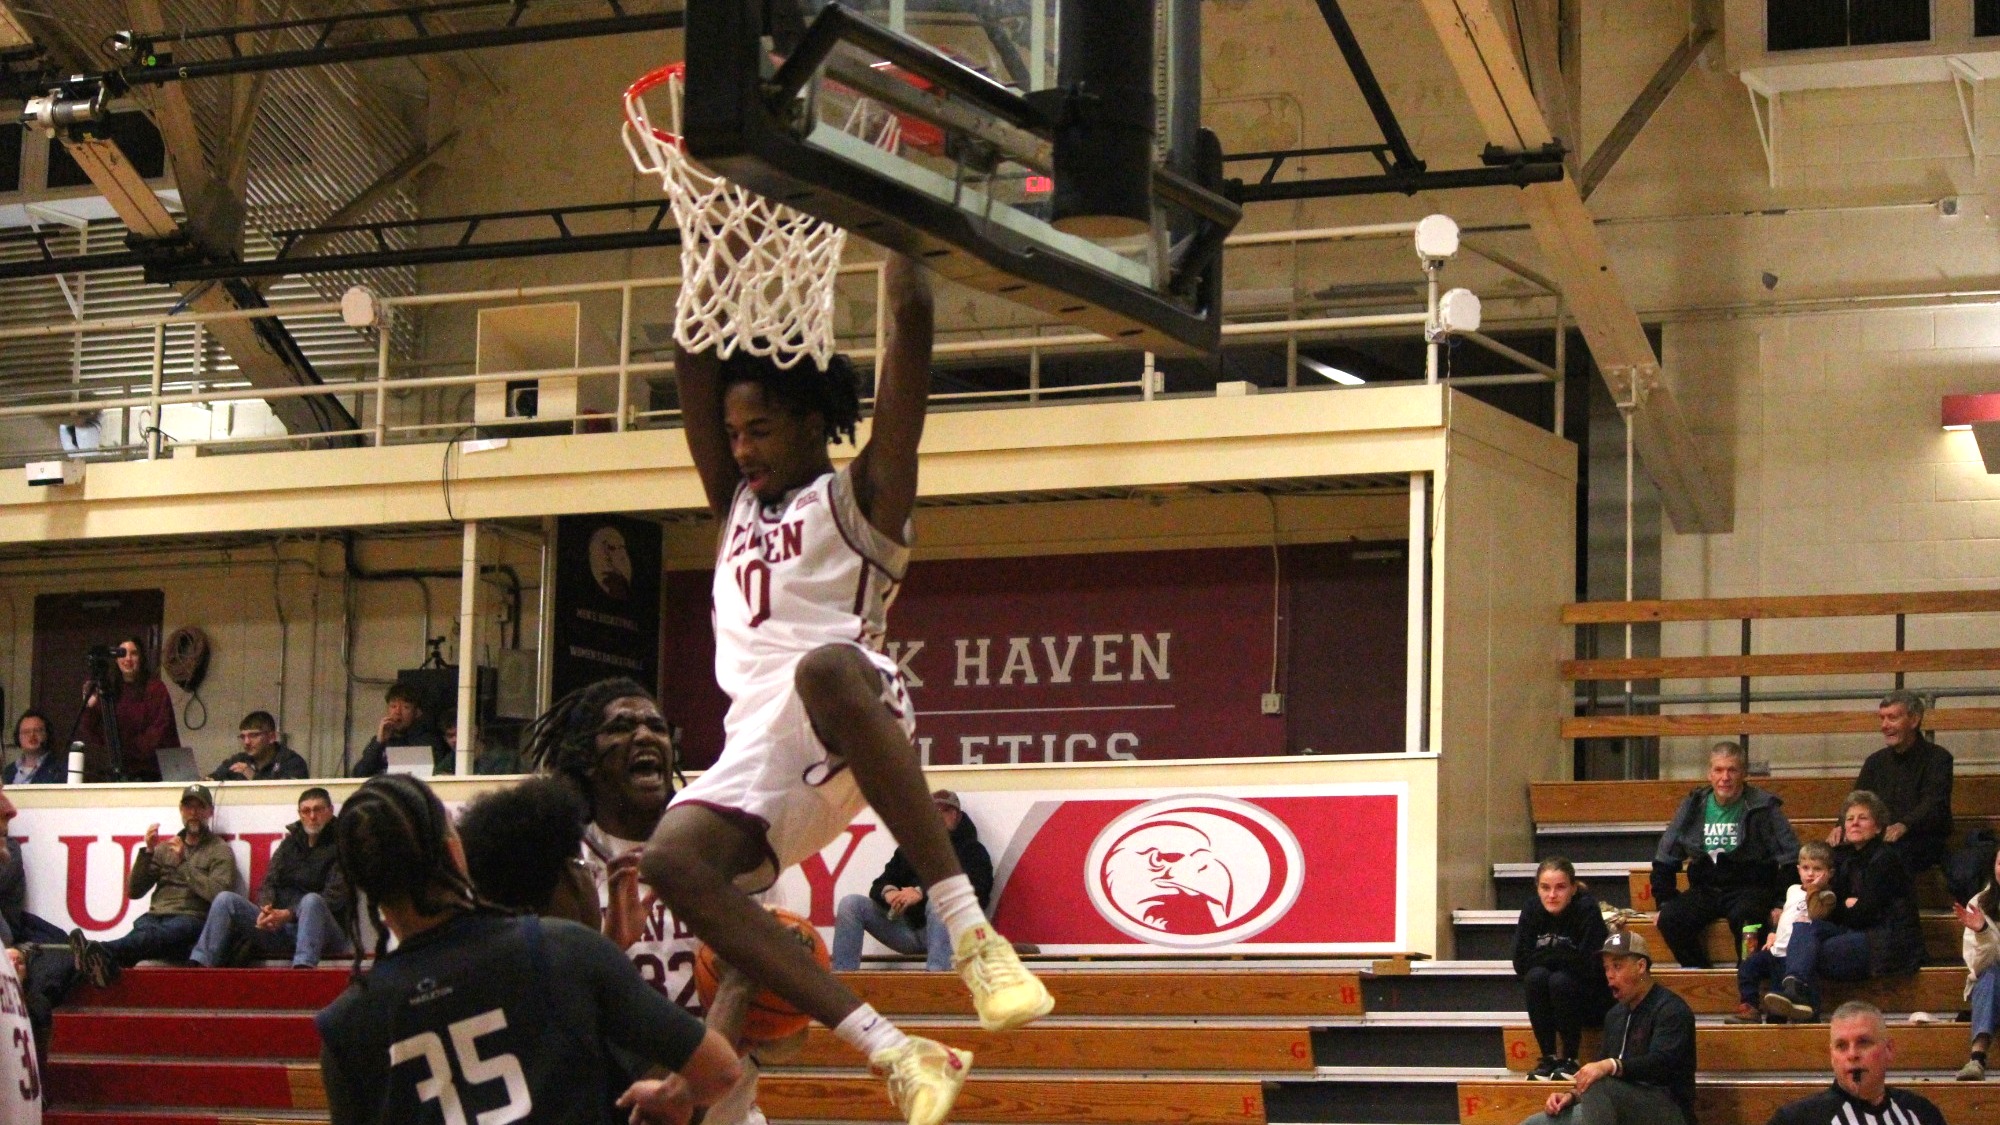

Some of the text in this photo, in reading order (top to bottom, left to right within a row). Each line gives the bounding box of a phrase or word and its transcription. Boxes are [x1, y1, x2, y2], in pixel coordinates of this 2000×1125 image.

[954, 632, 1171, 686] HAVEN
[1703, 836, 1738, 846] OCCE
[1290, 1041, 1307, 1059] G
[1511, 1041, 1527, 1059] G
[389, 1007, 532, 1125] 35
[1464, 1096, 1481, 1116] F
